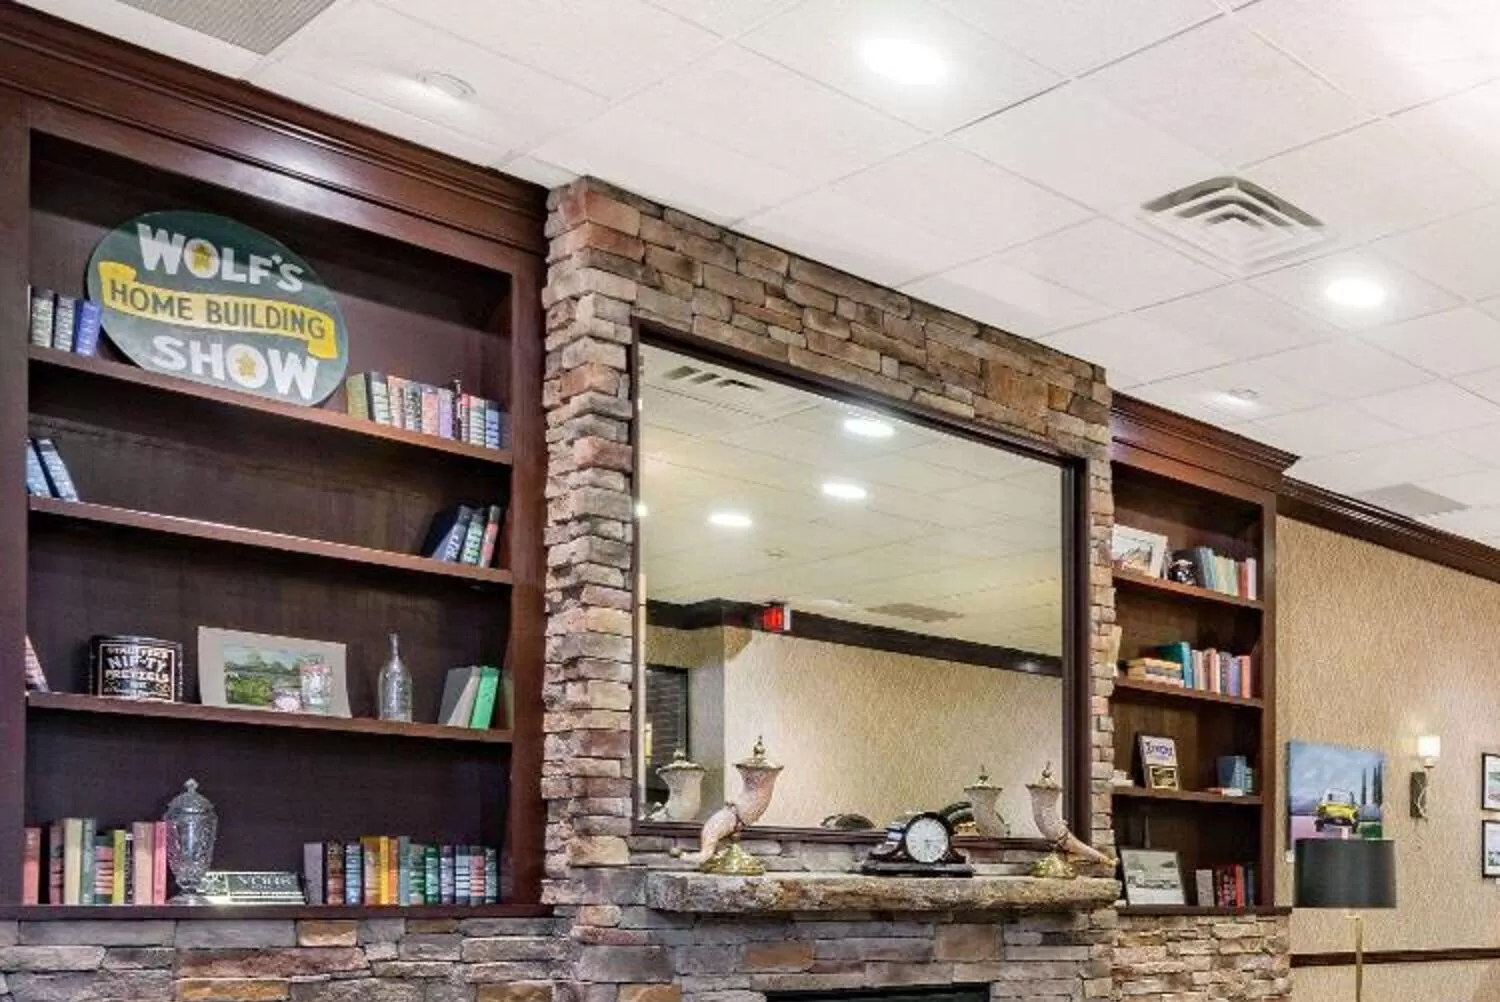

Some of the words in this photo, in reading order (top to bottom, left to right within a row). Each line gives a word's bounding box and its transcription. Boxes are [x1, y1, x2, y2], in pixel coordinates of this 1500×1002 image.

[137, 222, 304, 292] WOLF'S
[111, 279, 193, 320] HOME
[206, 299, 325, 340] BUILDING
[152, 335, 319, 400] SHOW
[105, 669, 169, 683] PRETZELS
